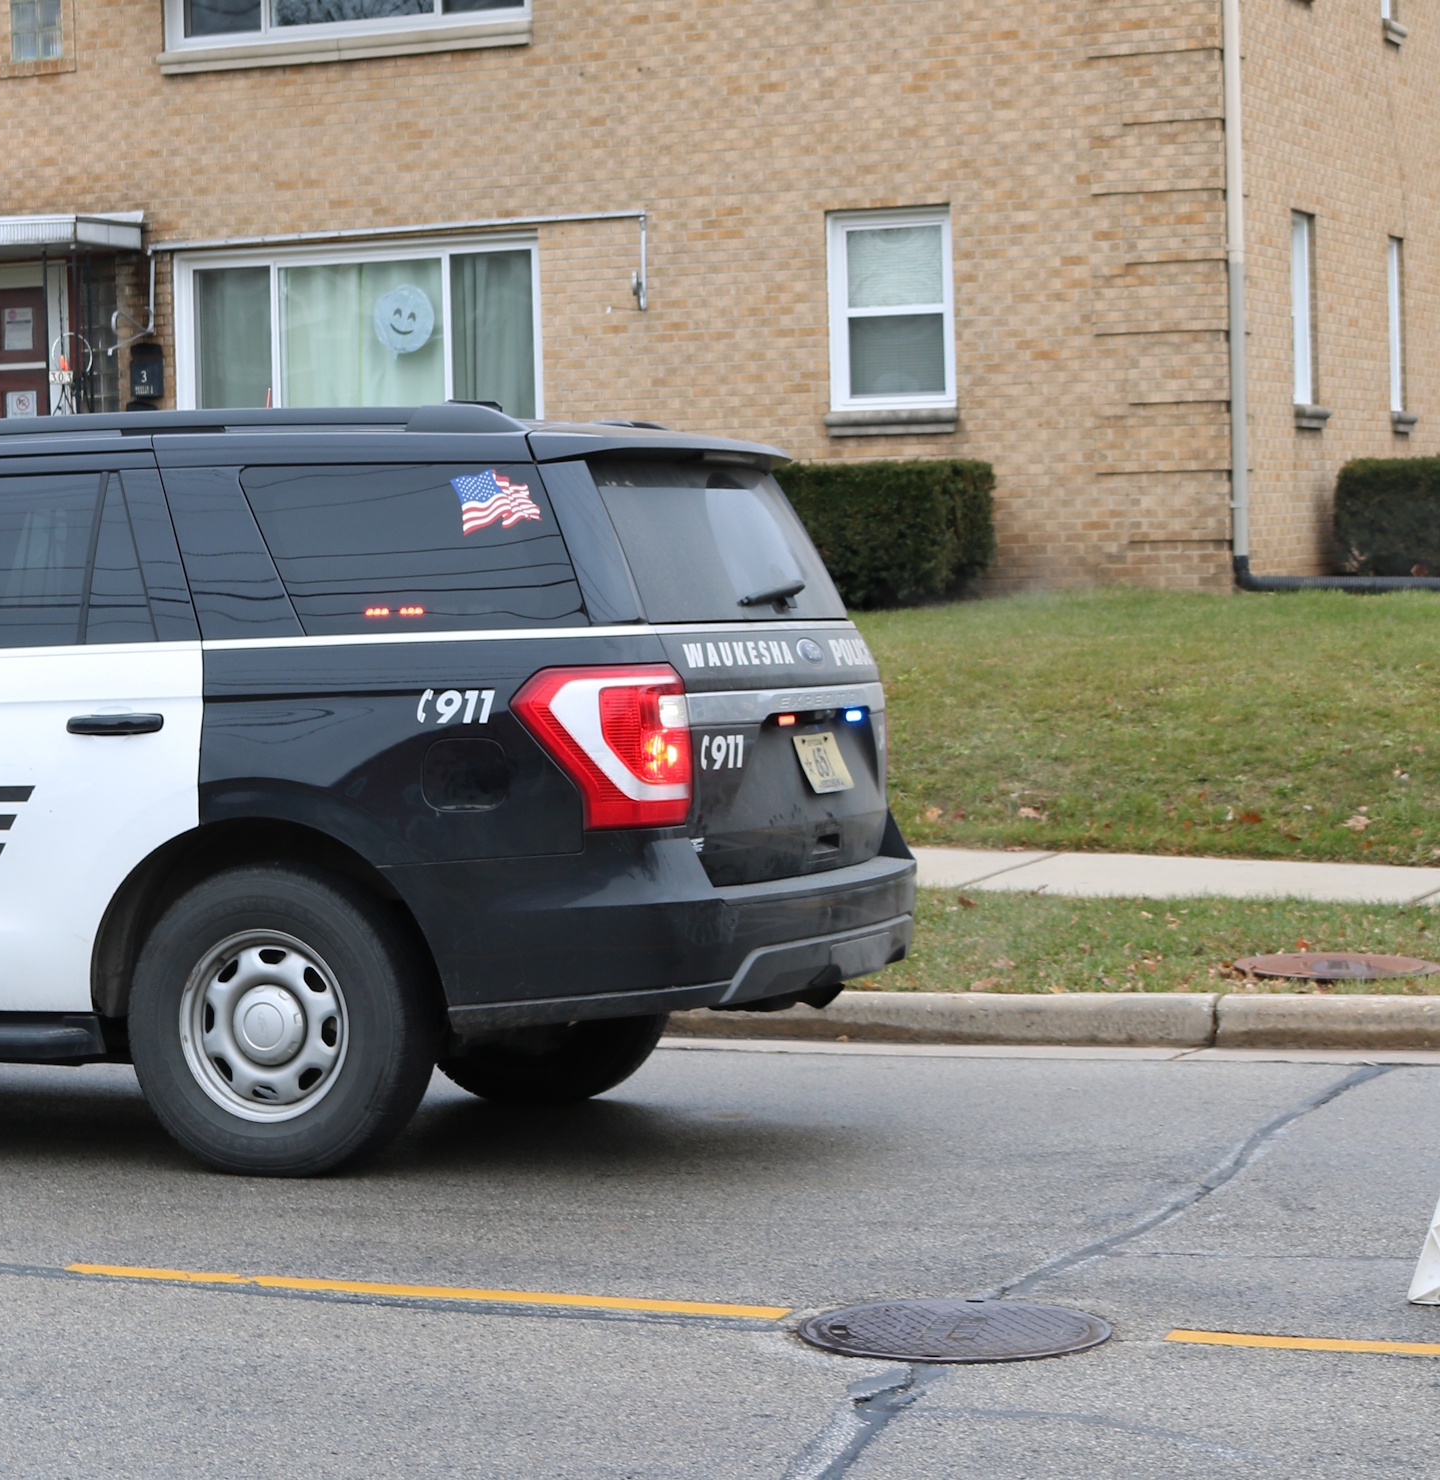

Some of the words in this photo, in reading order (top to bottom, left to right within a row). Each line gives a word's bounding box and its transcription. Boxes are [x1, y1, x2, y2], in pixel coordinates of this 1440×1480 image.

[50, 371, 72, 384] 303
[140, 370, 148, 383] 3
[682, 641, 795, 668] WAUKESHA
[436, 689, 496, 724] 911
[779, 692, 863, 709] EXPEDTO
[711, 734, 744, 770] 911
